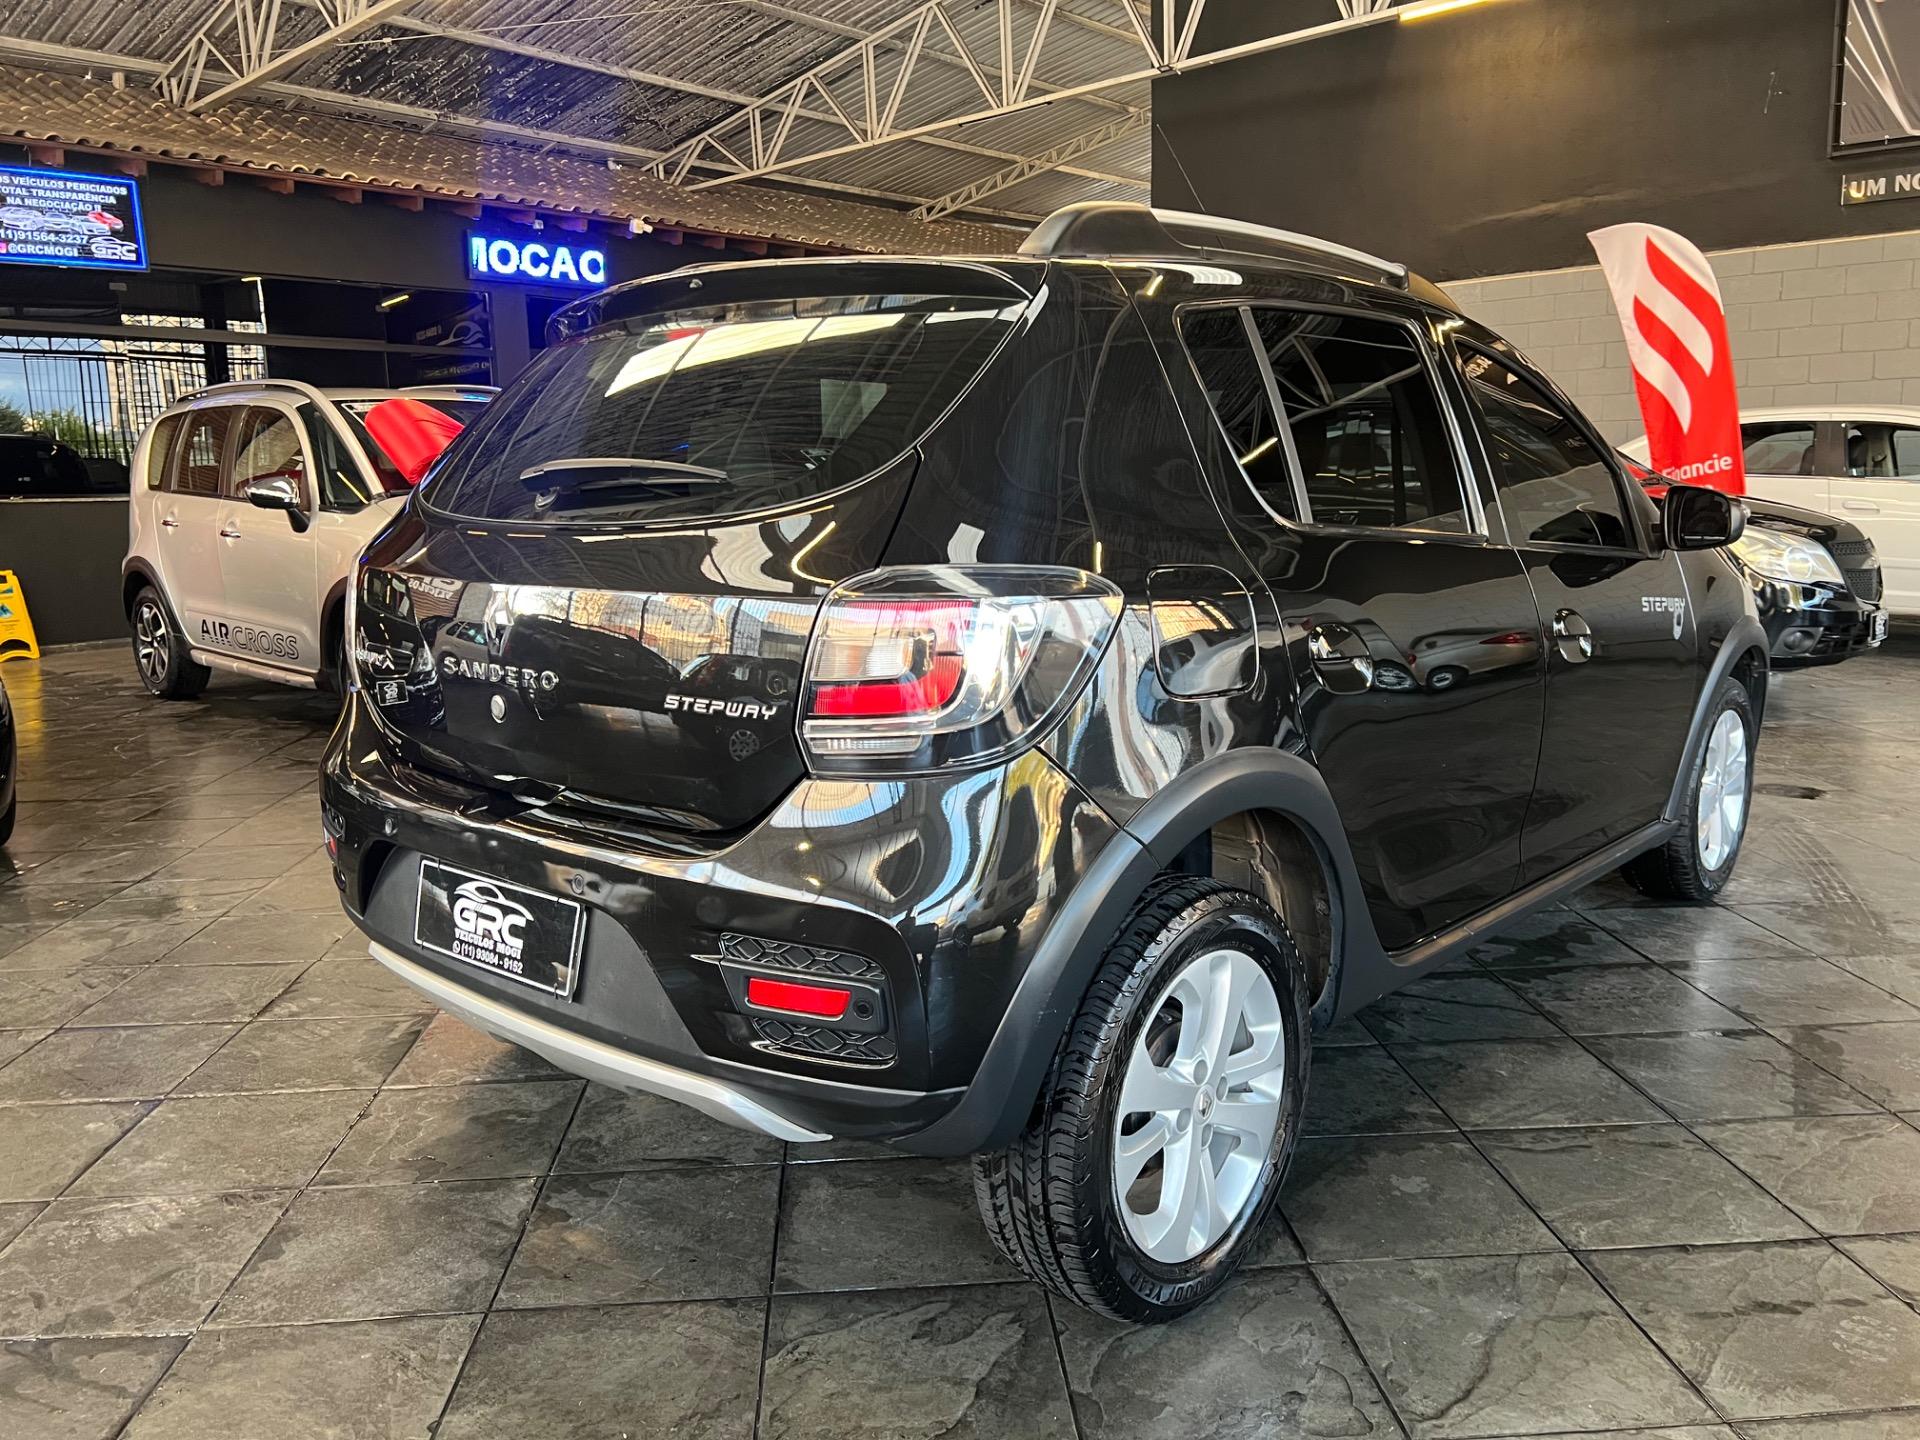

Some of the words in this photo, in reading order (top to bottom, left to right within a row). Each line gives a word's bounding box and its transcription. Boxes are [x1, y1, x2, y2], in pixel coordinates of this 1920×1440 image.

[0, 186, 29, 196] OTAL
[30, 189, 117, 204] TRANSPARÊNCIA
[11, 176, 64, 189] VEÍCULOS
[66, 182, 127, 195] PERICIADOS
[1849, 177, 1886, 198] UM
[6, 197, 23, 206] NA
[24, 198, 92, 212] NEGOCIAÇÃO
[7, 243, 79, 257] @GRCMOGI
[91, 243, 136, 257] GRC
[443, 655, 560, 693] SANDERO
[664, 694, 777, 721] STEPWAY
[453, 897, 527, 950] GRC
